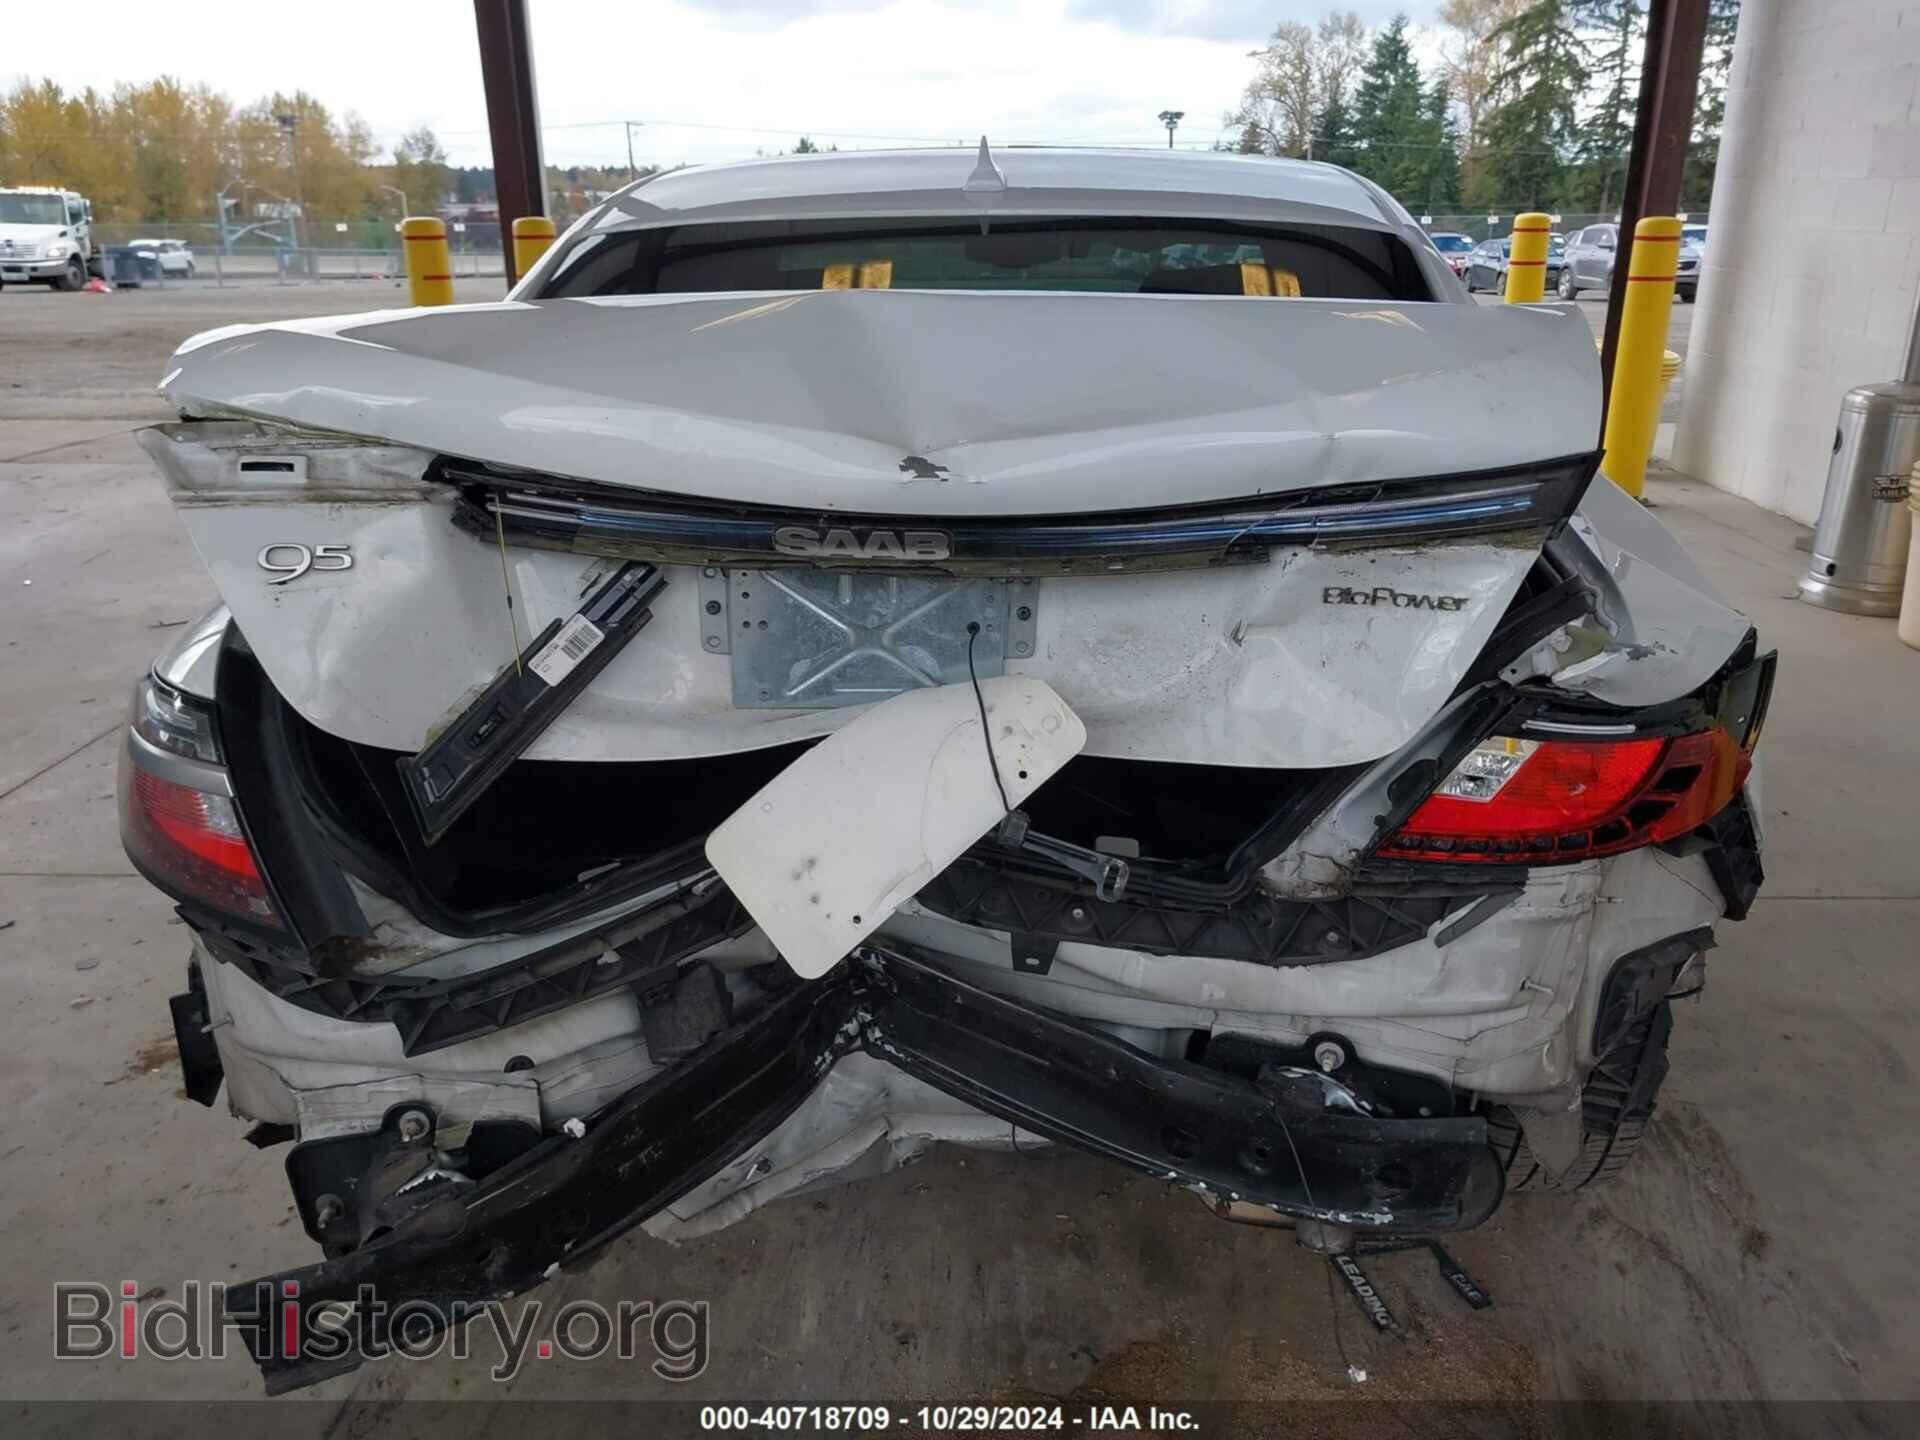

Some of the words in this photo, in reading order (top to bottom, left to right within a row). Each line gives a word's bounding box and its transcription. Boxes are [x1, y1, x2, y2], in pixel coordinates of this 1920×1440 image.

[774, 526, 951, 561] SAAB
[257, 542, 353, 585] 95
[1322, 586, 1469, 612] BioPower
[1336, 1255, 1391, 1326] LEADING
